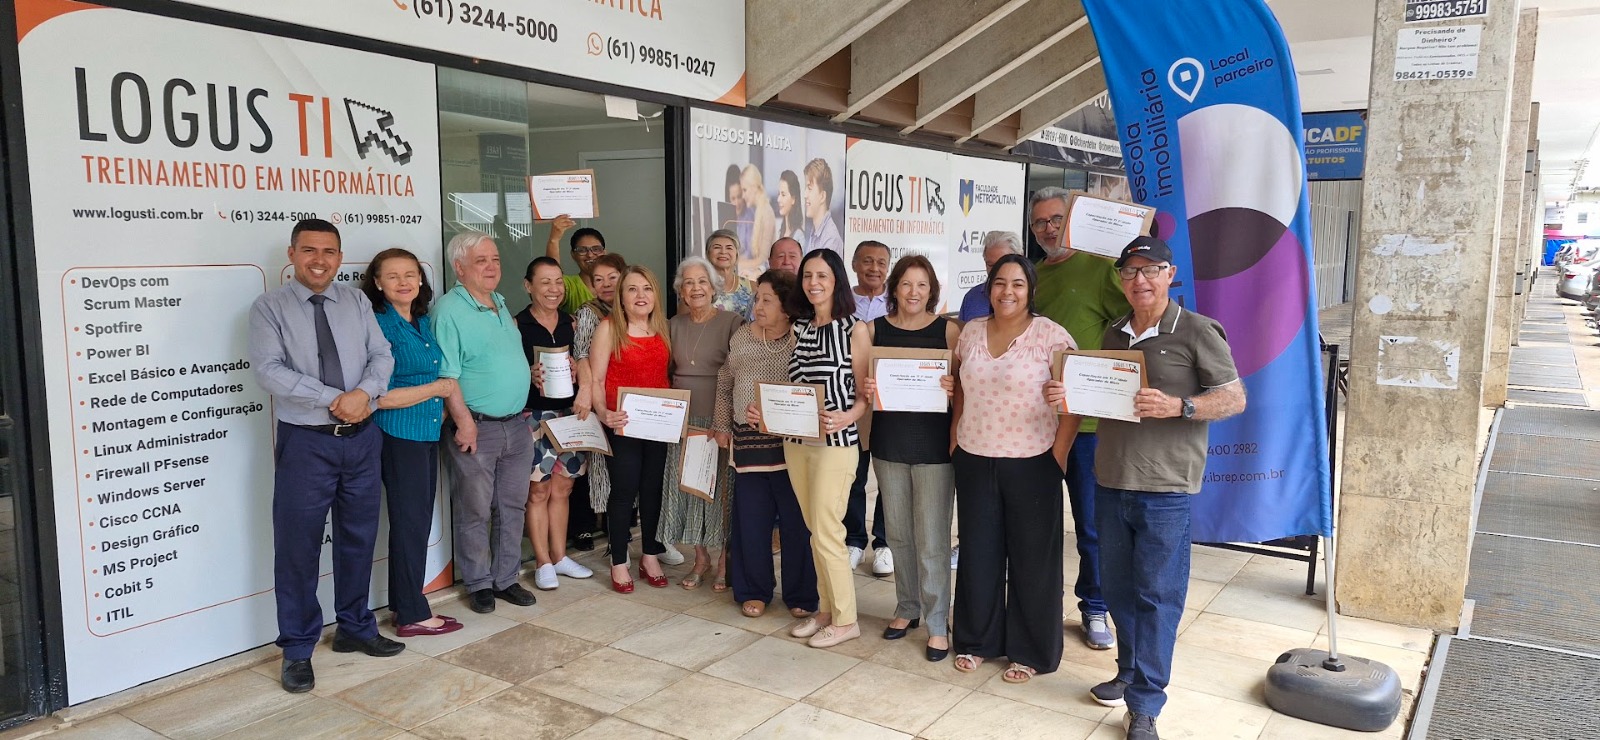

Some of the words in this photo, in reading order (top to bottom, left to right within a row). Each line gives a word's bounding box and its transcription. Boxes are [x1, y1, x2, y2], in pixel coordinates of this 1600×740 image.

[413, 0, 454, 25] (61)
[459, 2, 558, 43] 3244-5000
[1415, 0, 1484, 19] 99983-5751
[607, 36, 636, 64] (61)
[639, 45, 716, 78] 99851-0247
[1210, 48, 1249, 71] Local
[1214, 57, 1274, 88] parceiro
[1395, 70, 1466, 80] 98421-0539
[74, 66, 274, 154] LOGUS
[288, 92, 333, 158] TI
[695, 122, 744, 144] CURSOS
[747, 131, 763, 147] EM
[765, 135, 792, 152] ALTA
[1140, 67, 1173, 199] imobiliária
[1126, 122, 1148, 203] escola
[1317, 146, 1362, 154] PROFISSIONAL
[81, 155, 247, 190] TREINAMENTO
[255, 165, 283, 191] EM
[291, 166, 416, 197] INFORMÁTICA
[975, 184, 999, 193] FACULDADE
[849, 169, 904, 213] LOGUS
[908, 176, 922, 214] TI
[974, 193, 1017, 206] METROPOLITANA
[72, 207, 204, 222] www.logusti.com.br
[230, 210, 254, 224] (61)
[256, 210, 317, 223] 3244-5000
[344, 213, 364, 225] (61)
[366, 213, 423, 225] 99851-0247
[849, 217, 895, 235] TREINAMENTO
[896, 220, 905, 235] EM
[906, 217, 945, 236] INFORMÁTICA
[81, 276, 136, 290] DevOps
[140, 275, 169, 287] com
[337, 271, 350, 282] de
[960, 273, 975, 284] POLO
[84, 298, 131, 311] Scrum
[134, 296, 182, 309] Master
[85, 321, 143, 338] Spotfire
[86, 347, 132, 360] Power
[135, 344, 150, 356] BI
[88, 370, 127, 384] Excel
[130, 366, 175, 381] Básico
[179, 368, 187, 376] e
[190, 359, 251, 375] Avançado
[90, 393, 127, 409] Rede
[130, 392, 148, 404] de
[151, 382, 244, 402] Computadores
[92, 416, 167, 433] Montagem
[170, 414, 178, 423] e
[181, 401, 264, 421] Configuração
[94, 443, 133, 458] Linux
[136, 429, 228, 451] Administrador
[1233, 442, 1259, 455] 2982
[96, 462, 150, 482] Firewall
[154, 454, 209, 472] PFsense
[98, 486, 160, 505] Windows
[163, 477, 206, 493] Server
[99, 511, 139, 529] Cisco
[142, 503, 182, 520] CCNA
[101, 535, 149, 552] Design
[152, 523, 200, 541] Gráfico
[102, 561, 126, 576] MS
[130, 550, 178, 569] Project
[104, 581, 142, 600] Cobit
[145, 577, 154, 589] 5
[106, 607, 134, 623] ITIL
